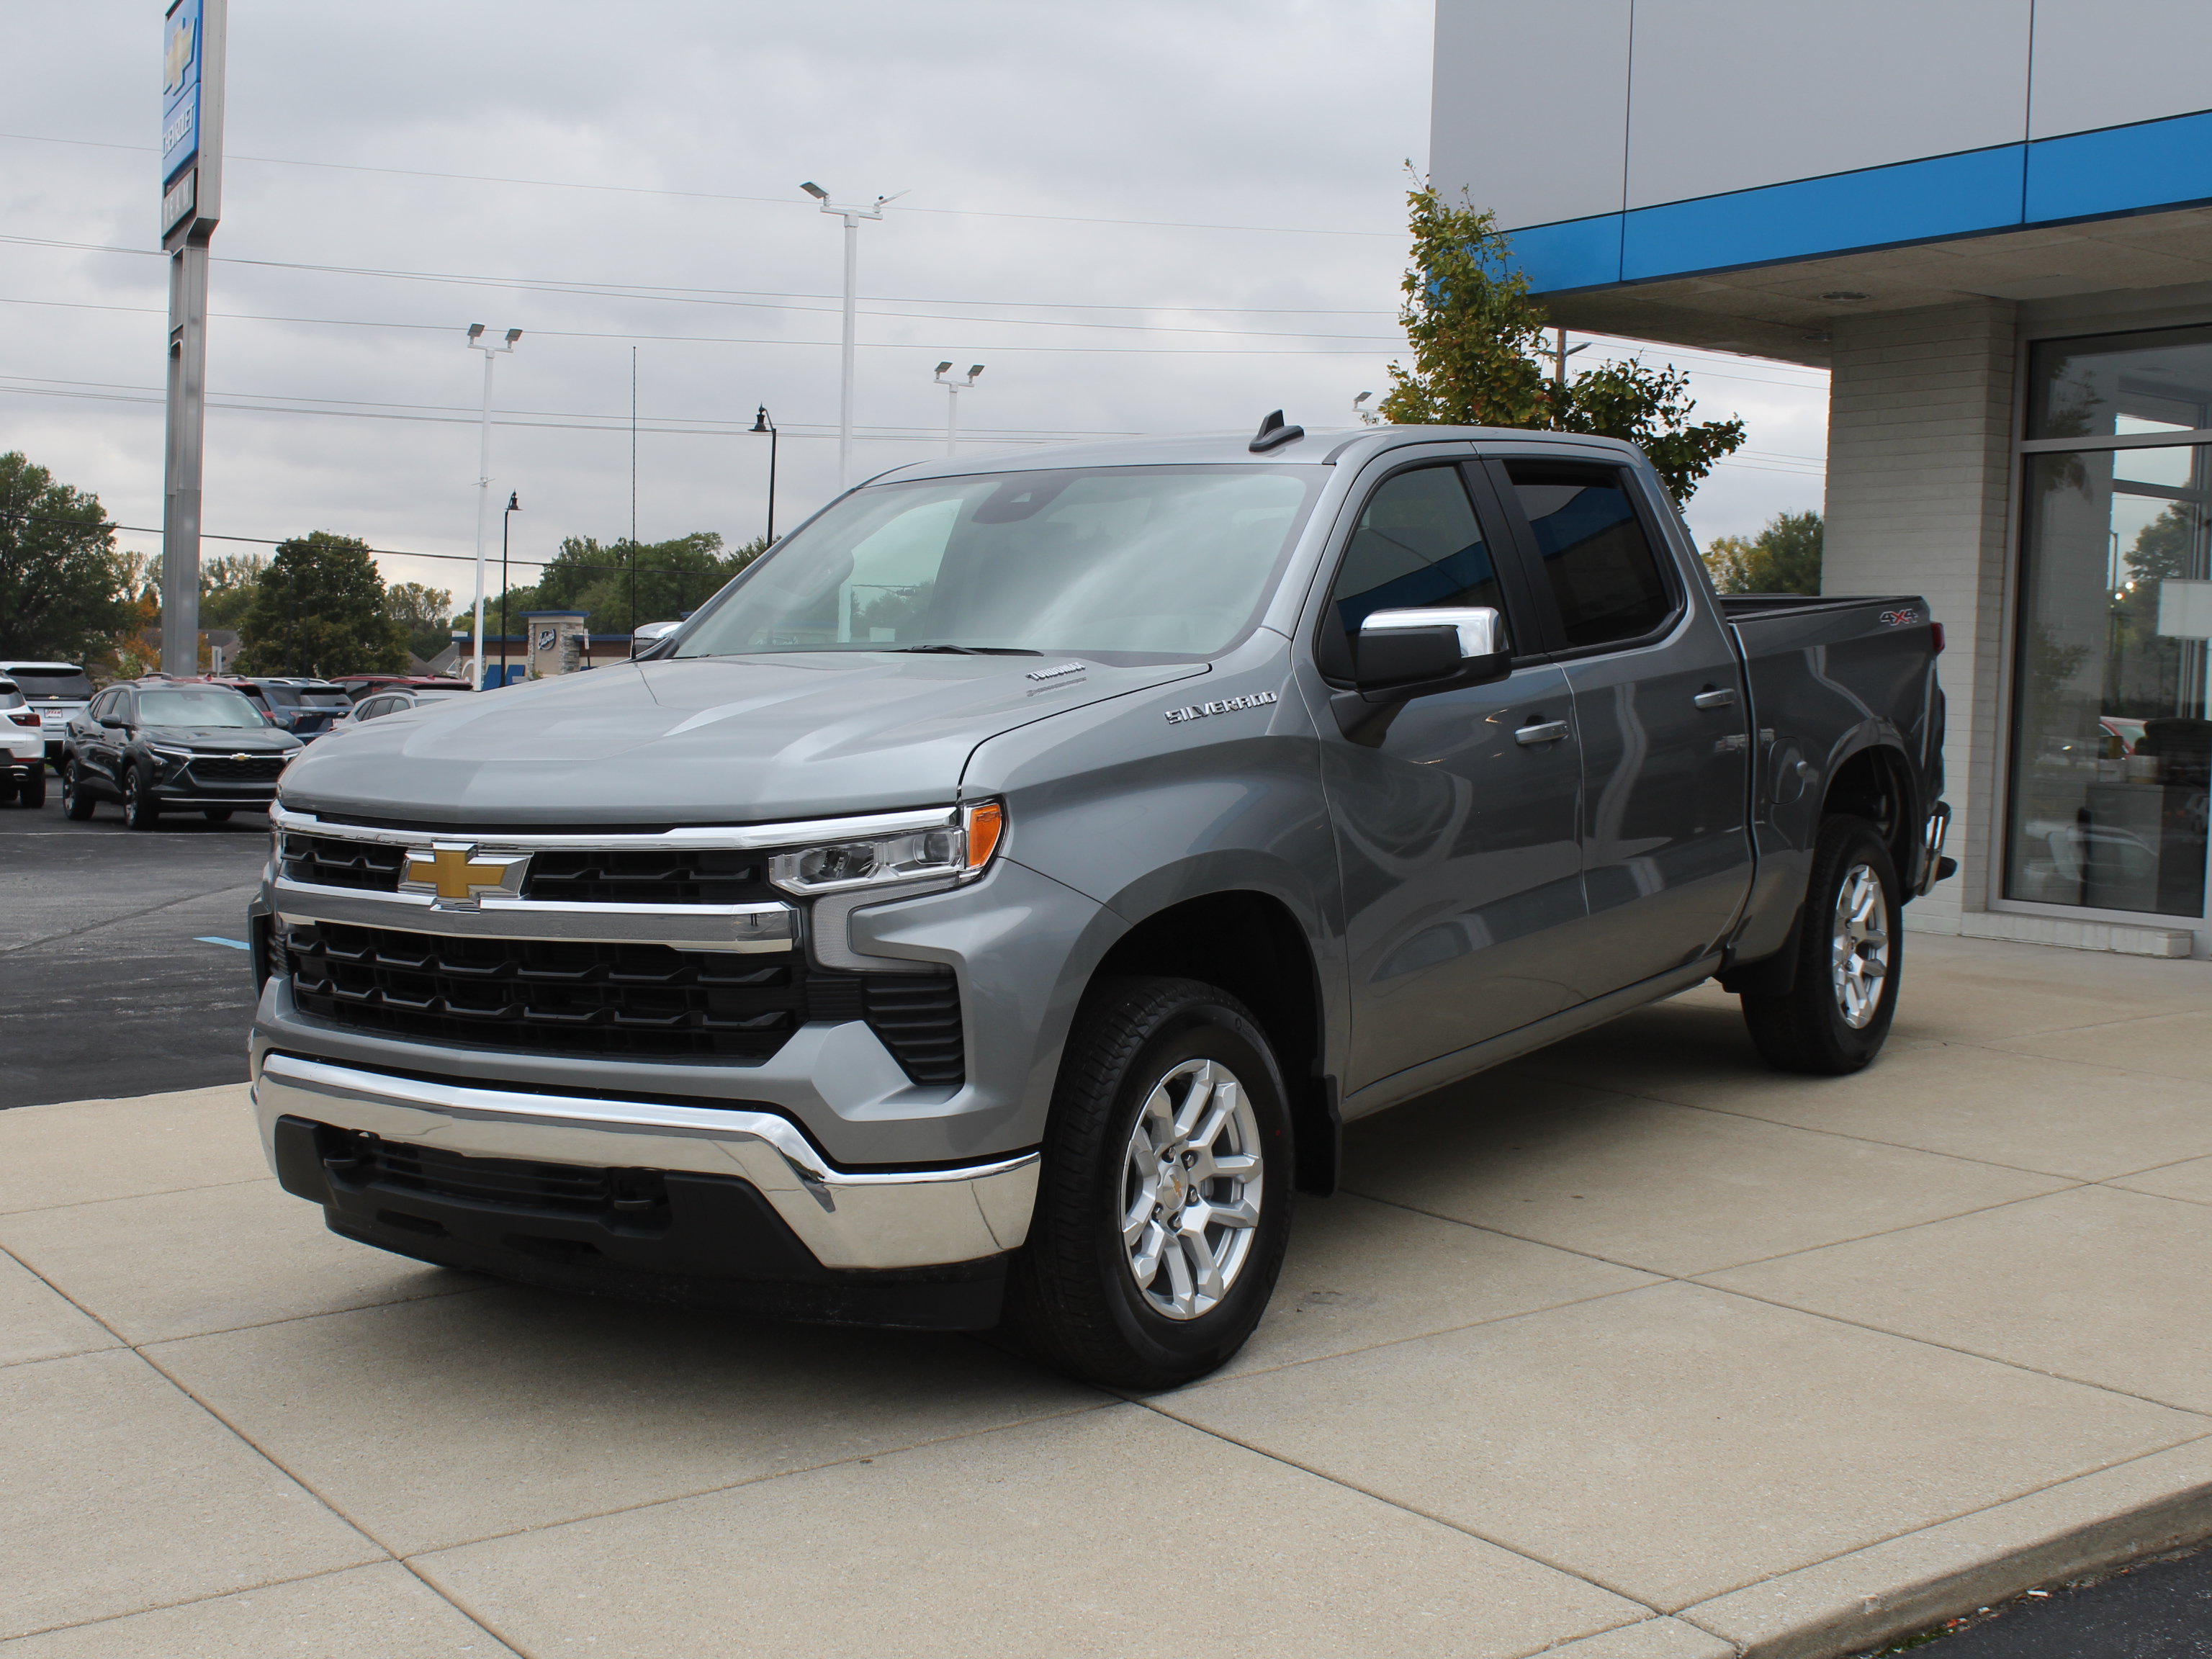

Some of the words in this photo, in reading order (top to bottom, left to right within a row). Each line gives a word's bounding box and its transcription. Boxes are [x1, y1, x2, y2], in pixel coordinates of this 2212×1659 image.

[164, 180, 189, 228] TEAM
[1025, 662, 1087, 681] TURBOMAX
[1164, 691, 1278, 724] SILVERADO
